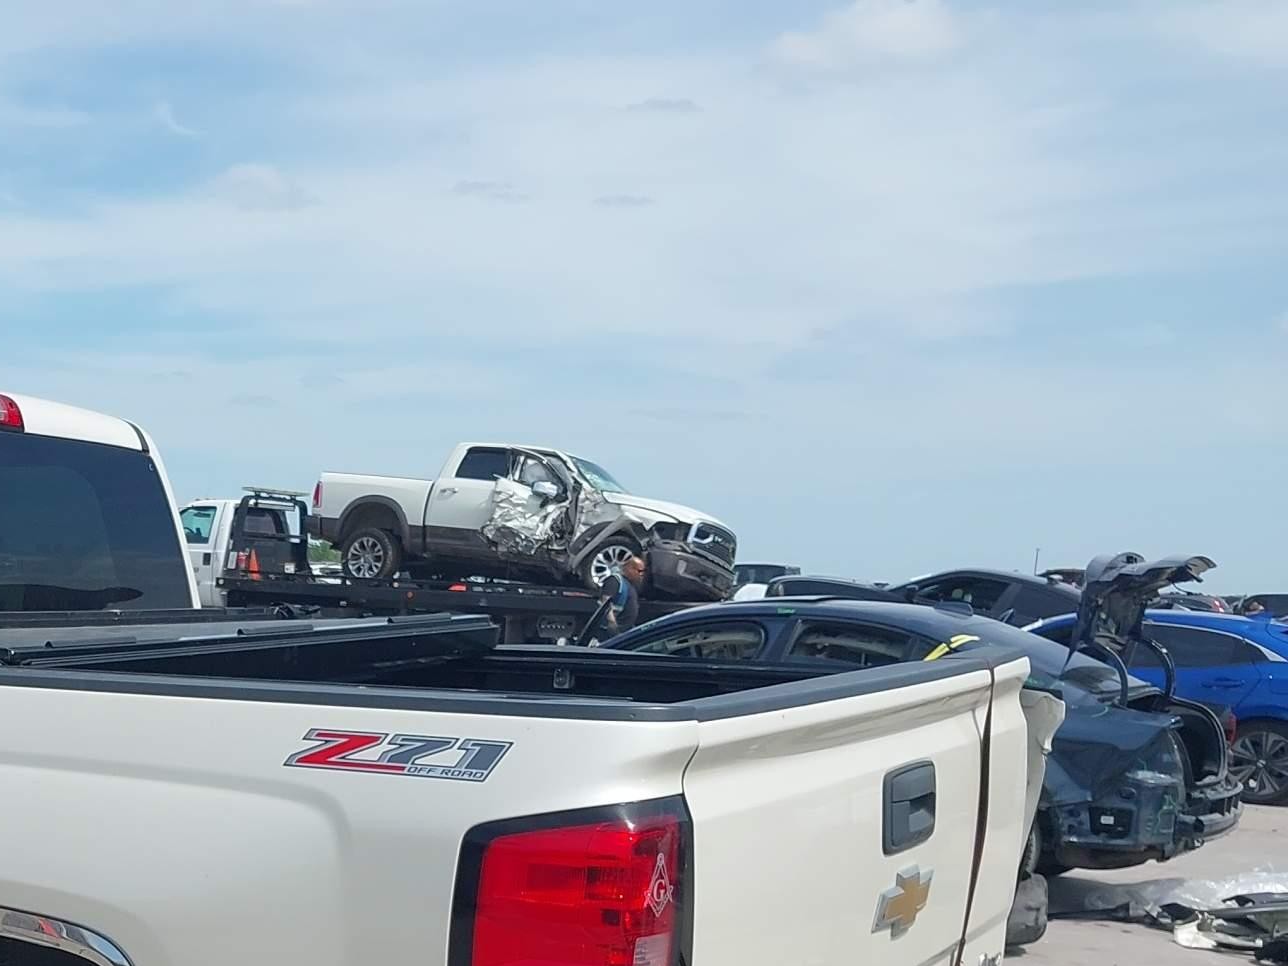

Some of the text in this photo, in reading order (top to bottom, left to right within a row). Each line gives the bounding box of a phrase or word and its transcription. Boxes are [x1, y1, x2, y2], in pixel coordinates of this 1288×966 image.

[284, 728, 513, 777] Z71
[406, 766, 485, 780] OFF ROAD
[653, 879, 666, 902] G
